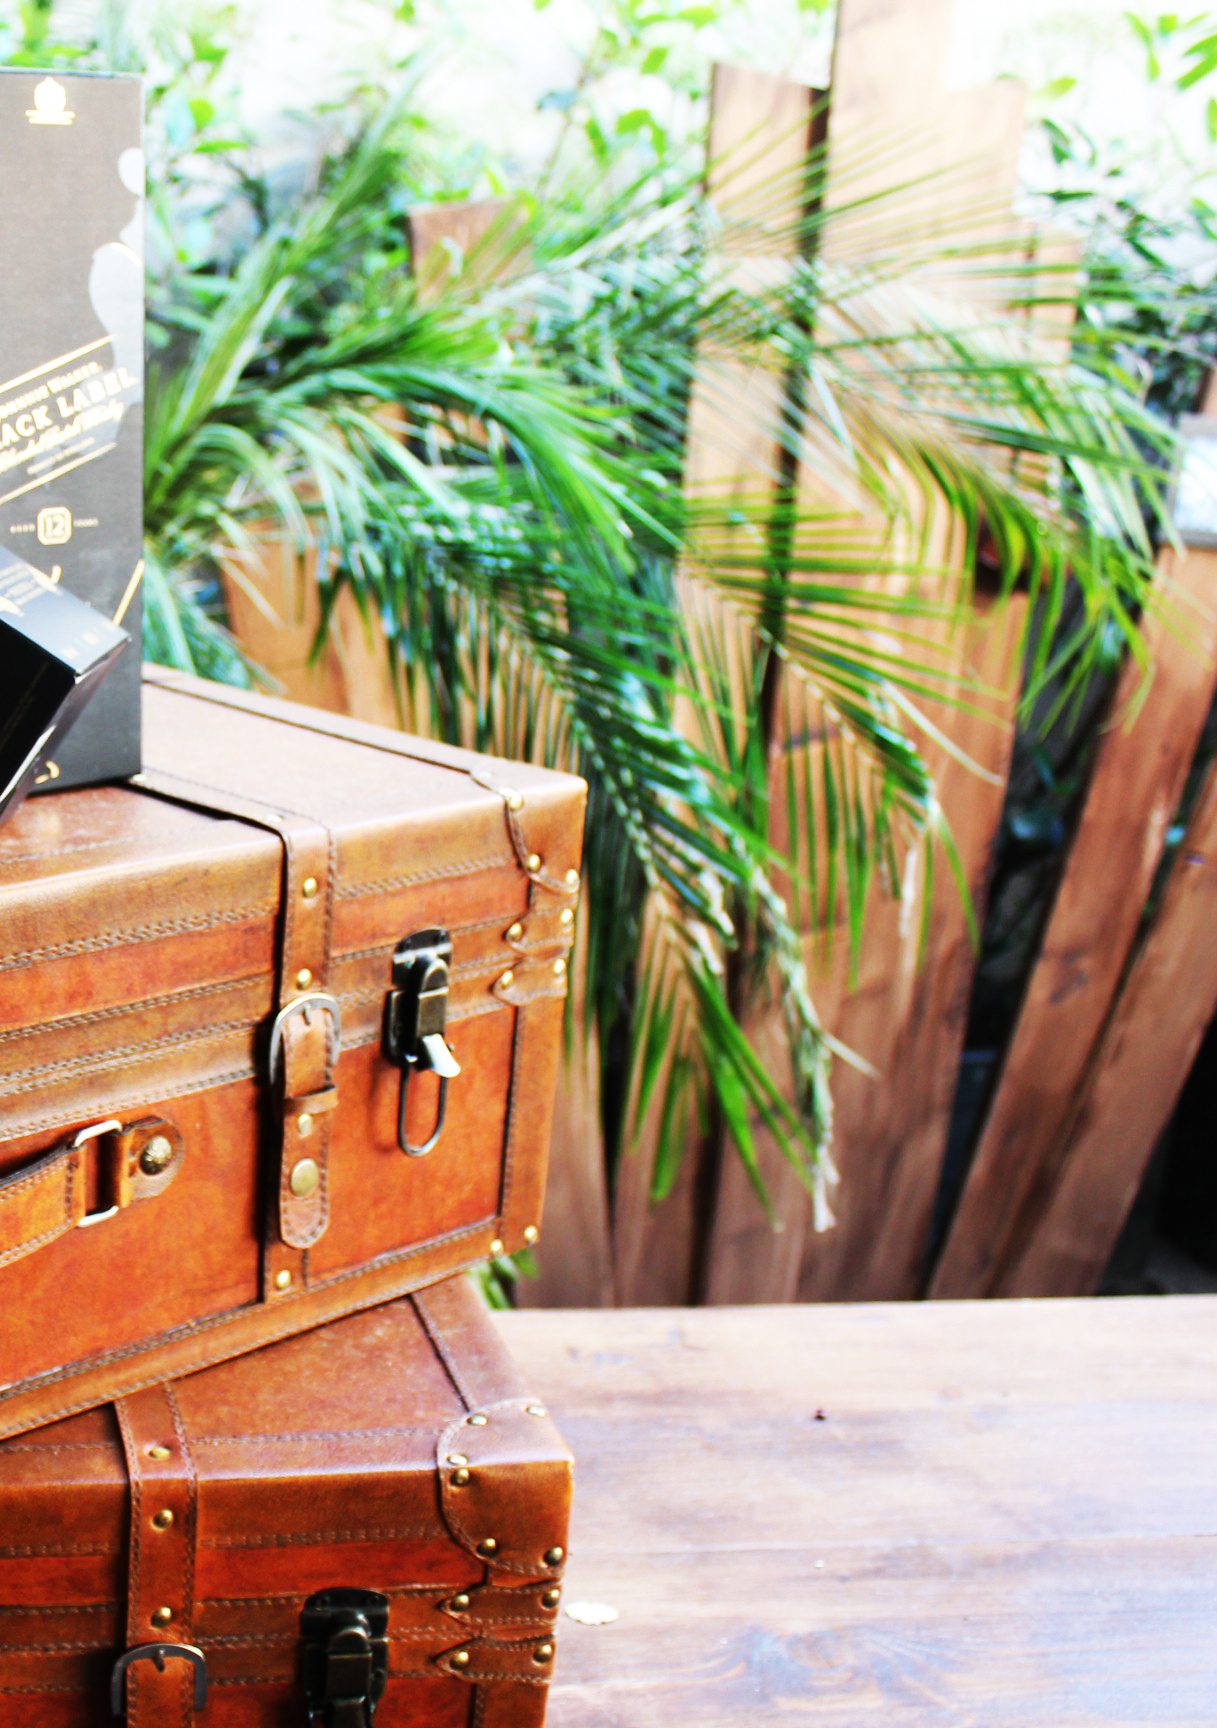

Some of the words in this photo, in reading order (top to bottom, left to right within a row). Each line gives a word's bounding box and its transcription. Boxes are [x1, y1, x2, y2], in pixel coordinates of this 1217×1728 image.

[46, 361, 101, 395] WALKER
[55, 366, 138, 419] LABEL
[43, 513, 66, 538] 12
